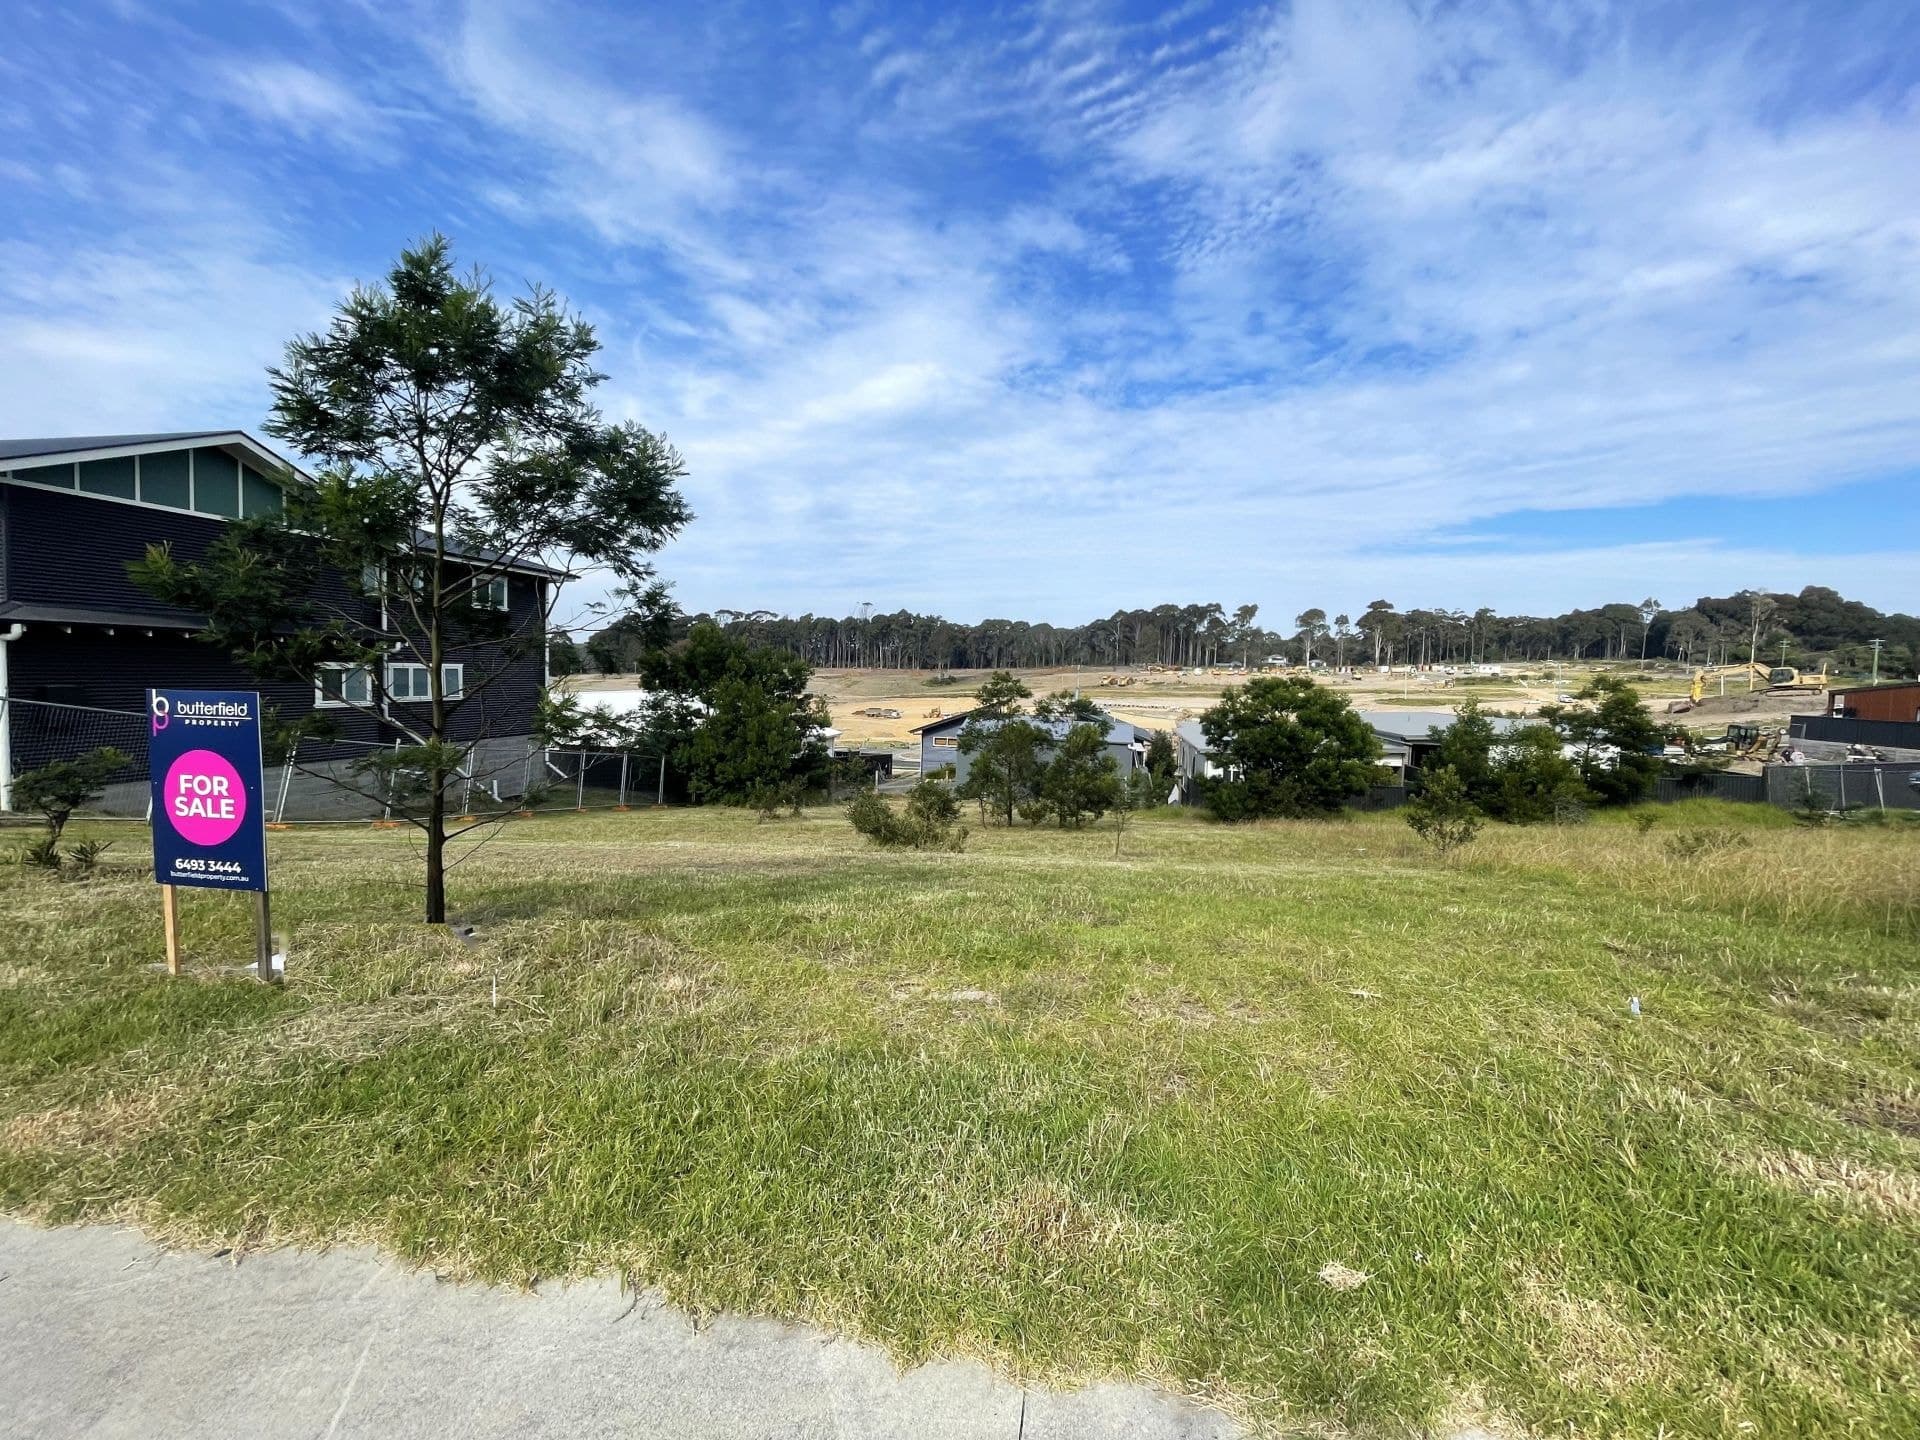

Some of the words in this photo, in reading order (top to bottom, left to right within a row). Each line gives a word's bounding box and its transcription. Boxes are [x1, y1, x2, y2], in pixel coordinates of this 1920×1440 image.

[177, 701, 248, 717] butterfield
[184, 719, 241, 728] PROPERTY
[179, 774, 229, 796] FOR
[174, 797, 236, 819] SALE
[175, 858, 206, 872] 6493
[207, 860, 242, 874] 3444
[170, 870, 250, 883] butterfieldproperty.com.au
